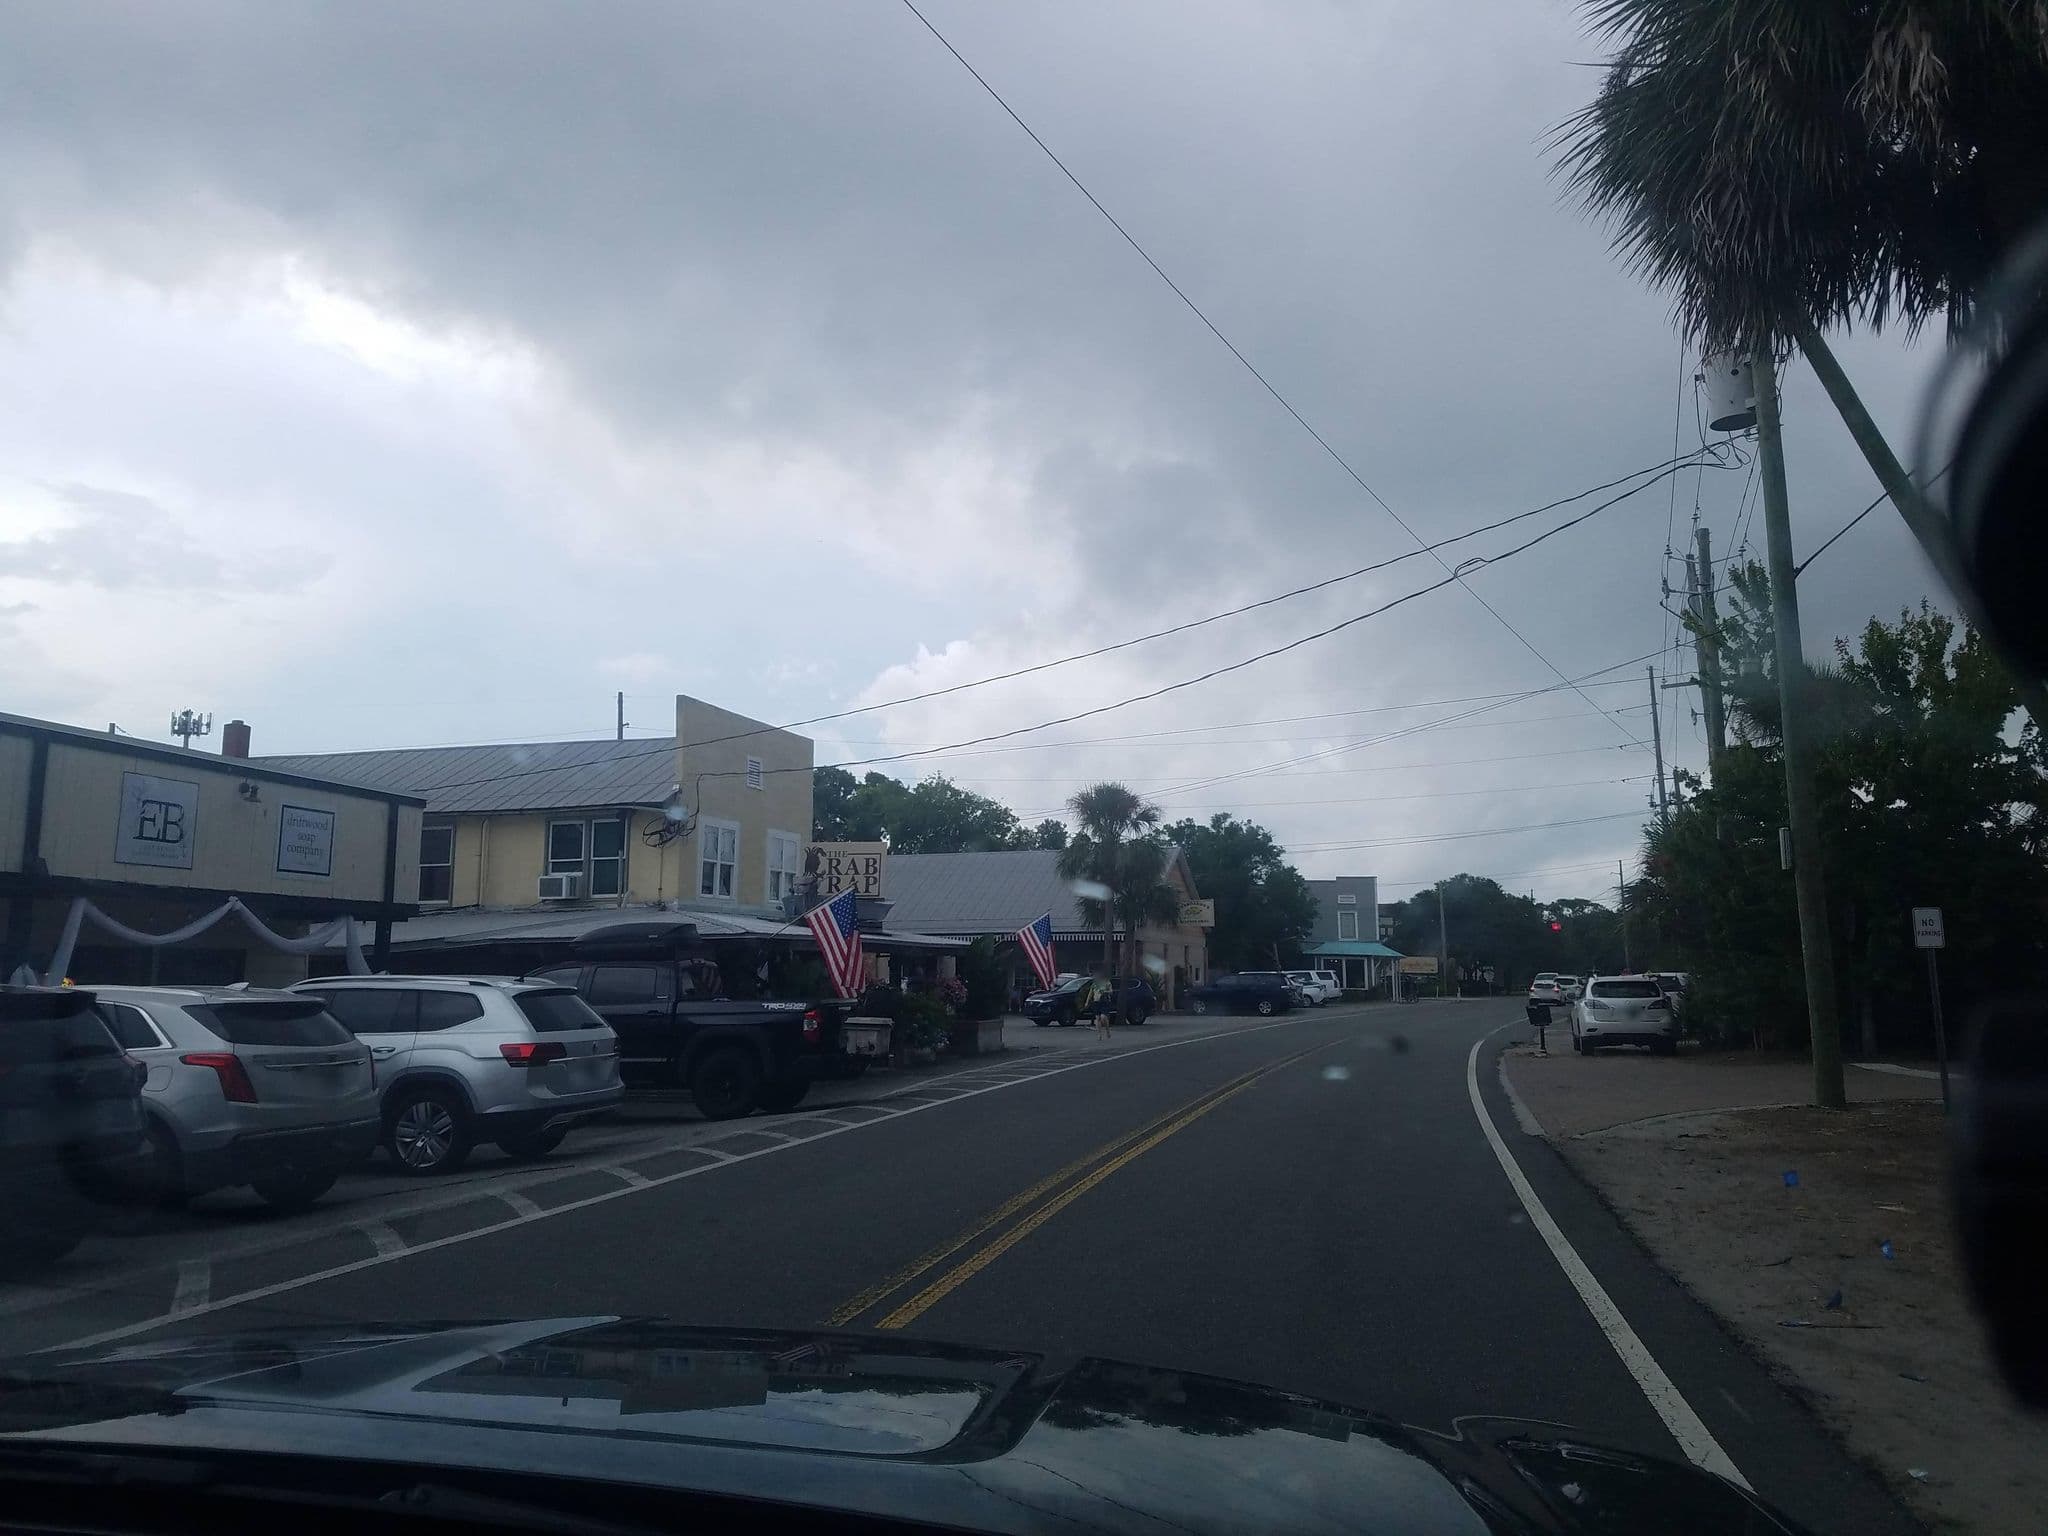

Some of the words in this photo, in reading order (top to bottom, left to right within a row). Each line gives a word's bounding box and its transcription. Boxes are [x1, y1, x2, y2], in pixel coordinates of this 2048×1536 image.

[133, 799, 185, 844] EB
[286, 812, 329, 831] driftwood
[297, 832, 317, 846] soap
[286, 844, 325, 860] company
[827, 850, 848, 858] THE
[1921, 918, 1935, 927] NO
